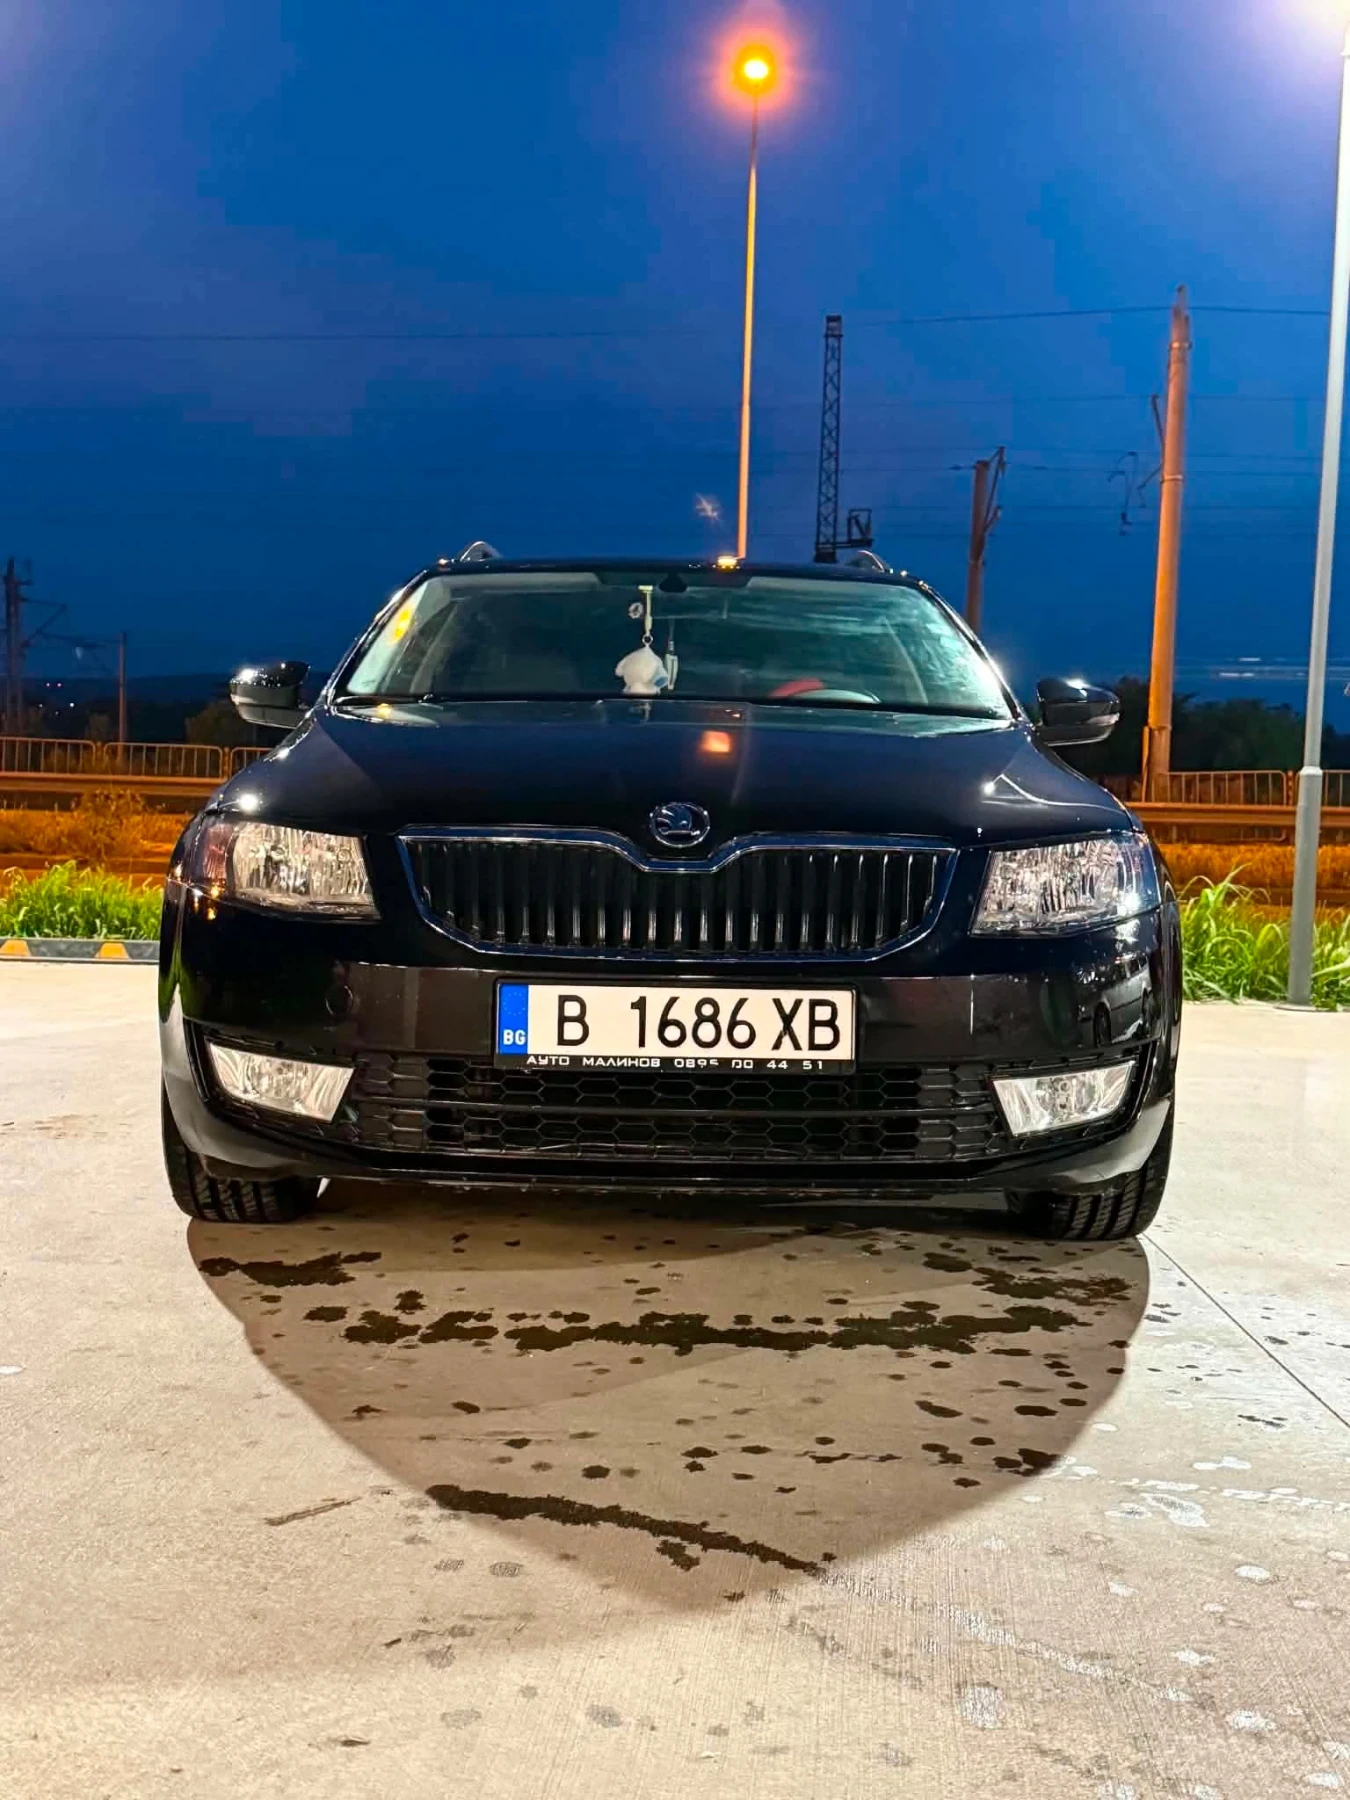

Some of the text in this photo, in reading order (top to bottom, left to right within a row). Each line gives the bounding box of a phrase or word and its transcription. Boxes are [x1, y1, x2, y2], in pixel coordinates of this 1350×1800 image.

[557, 994, 841, 1051] B 1686 XB
[503, 1029, 526, 1046] BG
[526, 1055, 570, 1066] АУТО
[582, 1057, 661, 1068] МАЛИНОВ
[766, 1060, 788, 1070] 44
